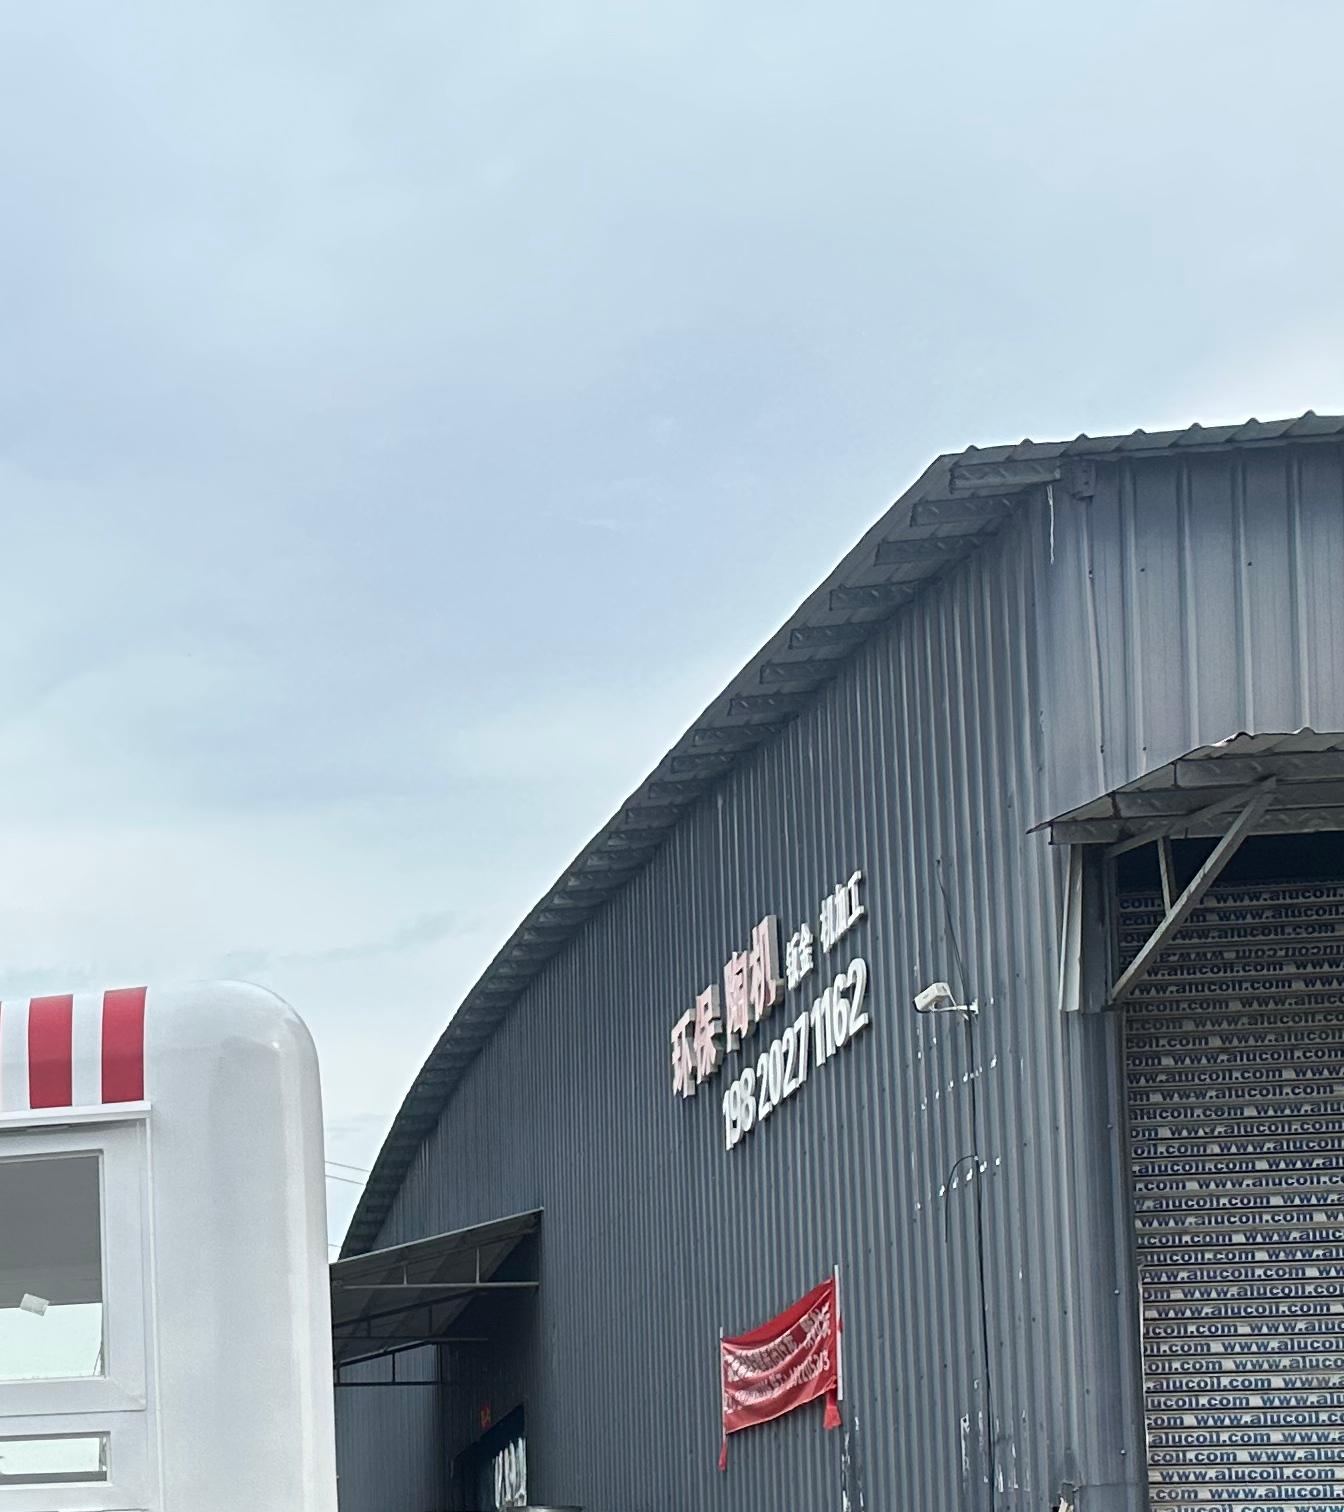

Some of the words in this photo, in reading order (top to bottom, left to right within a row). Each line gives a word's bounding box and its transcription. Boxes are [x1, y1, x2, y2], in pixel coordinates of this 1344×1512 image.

[1161, 1083, 1334, 1101] www.alucoil.com
[1169, 1118, 1343, 1137] www.alucoil.com
[1133, 1143, 1207, 1156] oil.com
[1140, 1210, 1313, 1227] www.alucoil.com
[1181, 1281, 1344, 1298] www.alucoil.co
[1156, 1300, 1330, 1317] www.alucoil.com
[1146, 1375, 1271, 1390] .alucoil.com
[1151, 1431, 1271, 1444] alucoil.com
[1150, 1451, 1237, 1462] coil.com
[1160, 1466, 1335, 1481] www.alucoil.com
